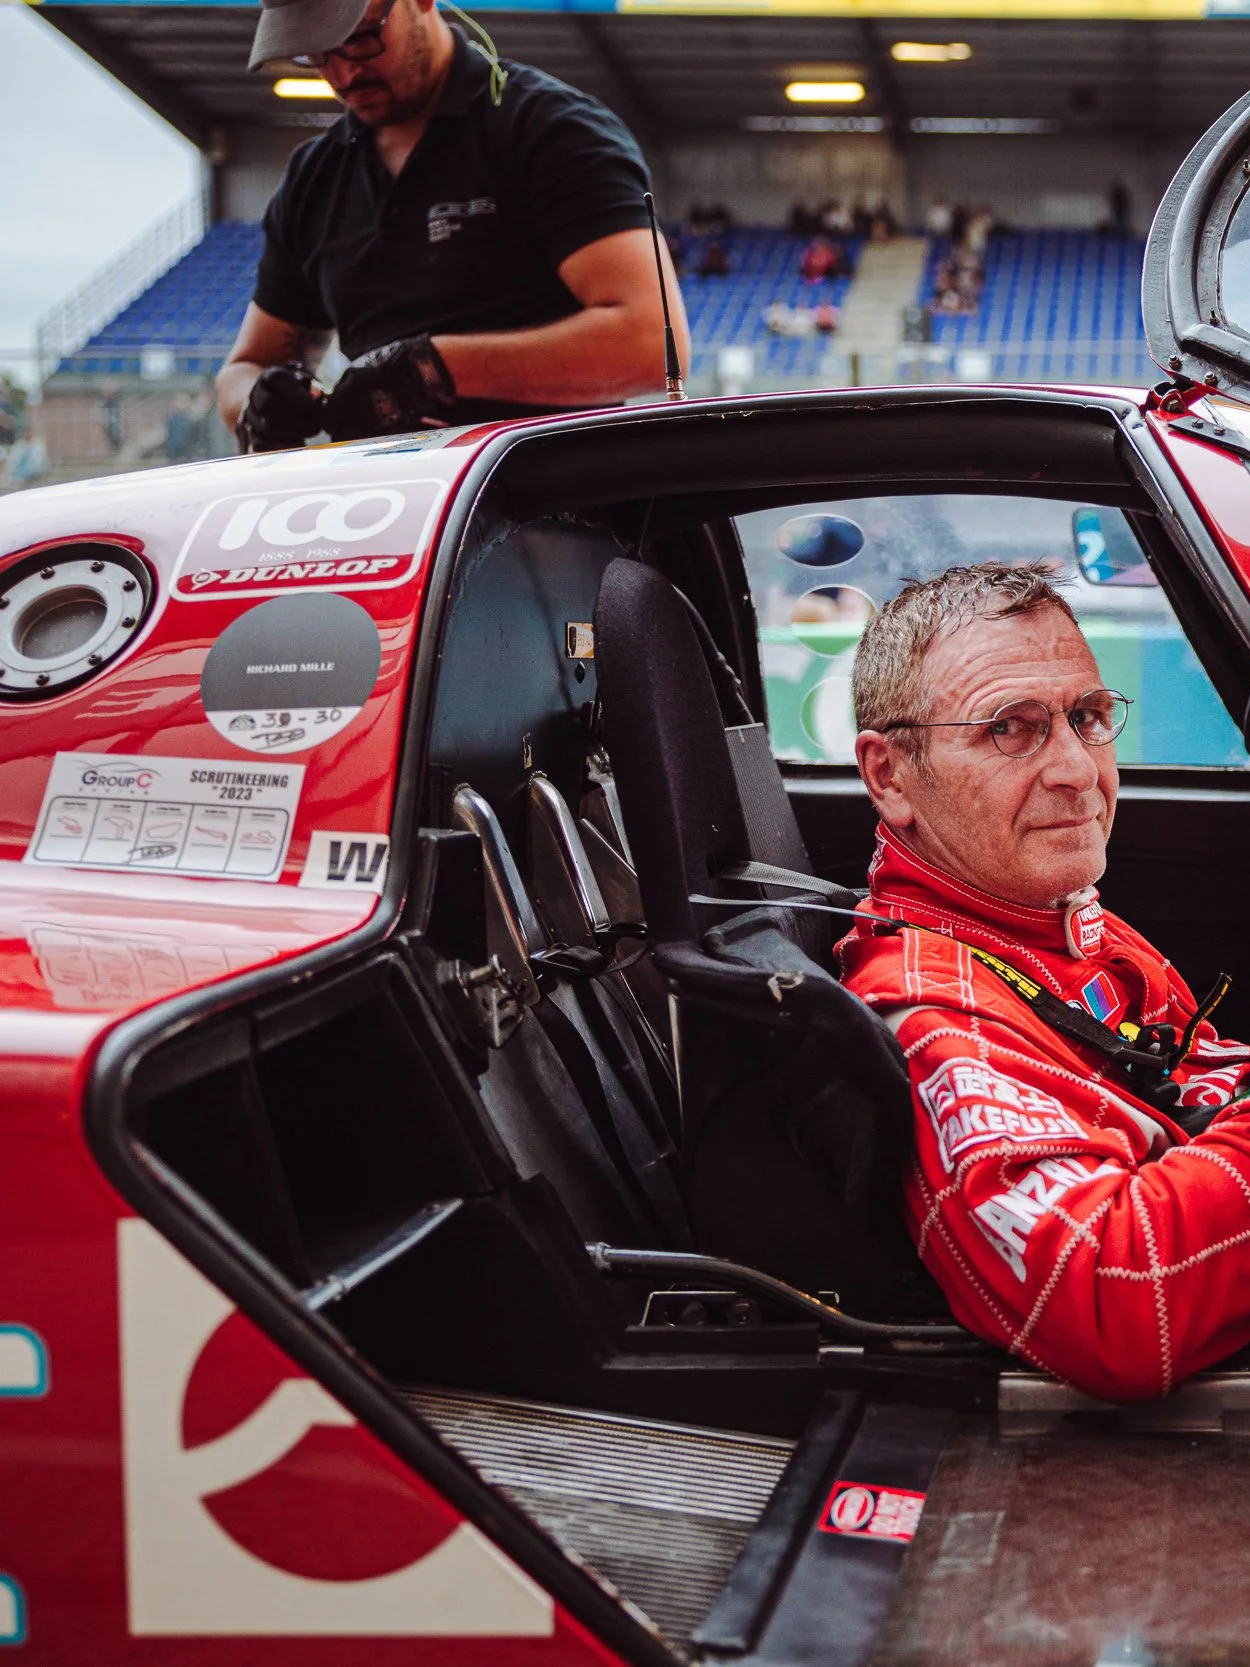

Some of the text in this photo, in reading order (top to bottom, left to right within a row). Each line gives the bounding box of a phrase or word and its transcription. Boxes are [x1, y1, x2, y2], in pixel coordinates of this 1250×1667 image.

[220, 558, 399, 584] DUNLOP
[247, 662, 335, 674] RICHARD MILLE
[190, 770, 289, 789] SCRUTINEERING
